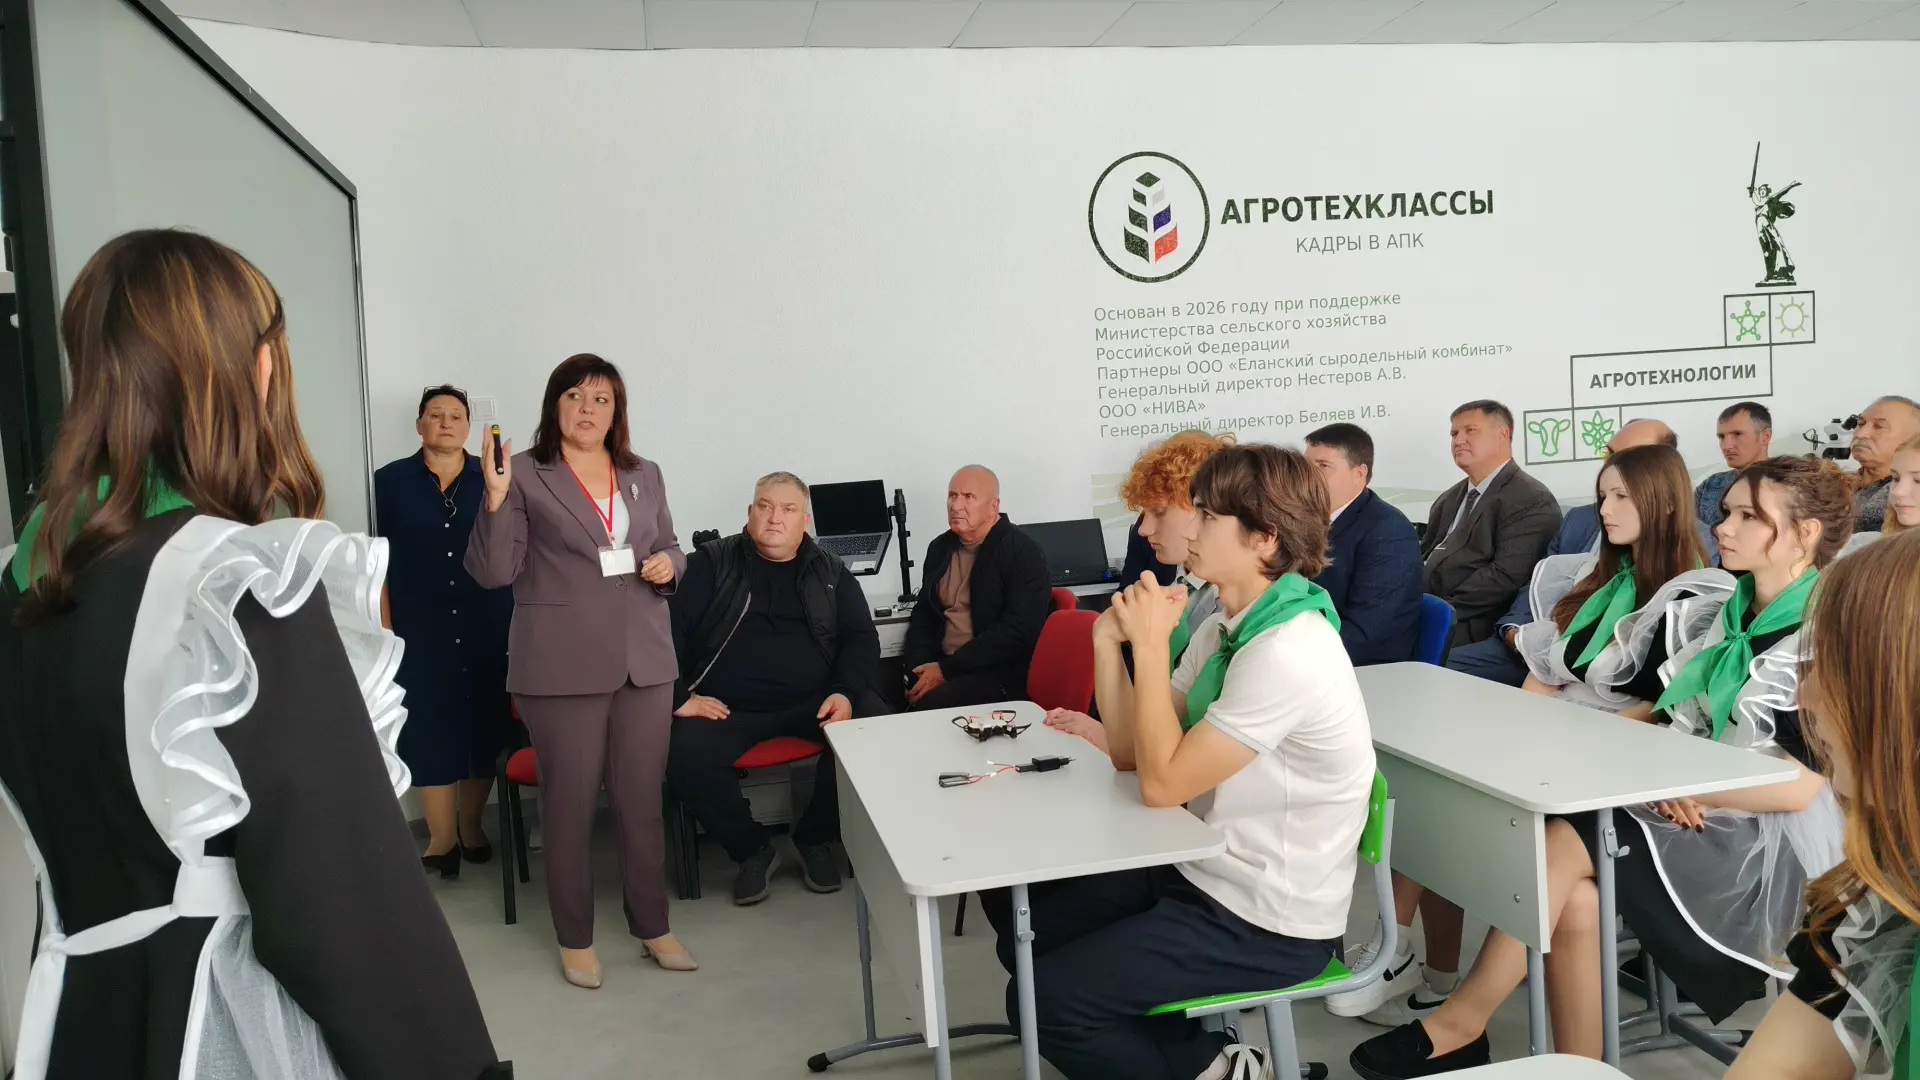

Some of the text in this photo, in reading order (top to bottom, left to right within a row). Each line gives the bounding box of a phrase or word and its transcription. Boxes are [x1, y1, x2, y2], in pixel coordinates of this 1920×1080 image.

[1221, 190, 1495, 225] АГРОТЕХКЛАССЫ
[1295, 233, 1425, 255] КАДРЫ В АПК
[1094, 293, 1401, 321] Основан в 2026 году при поддержке
[1095, 313, 1387, 341] Министерства сельского хозяйства
[1096, 338, 1290, 361] Российской Федерации
[1097, 343, 1513, 382] Партнеры ООО «Еланский сыродельный комбинат»
[1098, 367, 1407, 400] Генеральный директор Нестеров А.В.
[1589, 363, 1757, 390] АГРОТЕХНОЛОГИИ
[1099, 399, 1206, 419] ООО «НИВА»
[1100, 404, 1392, 438] Генеральный директор Беляев И.В.
